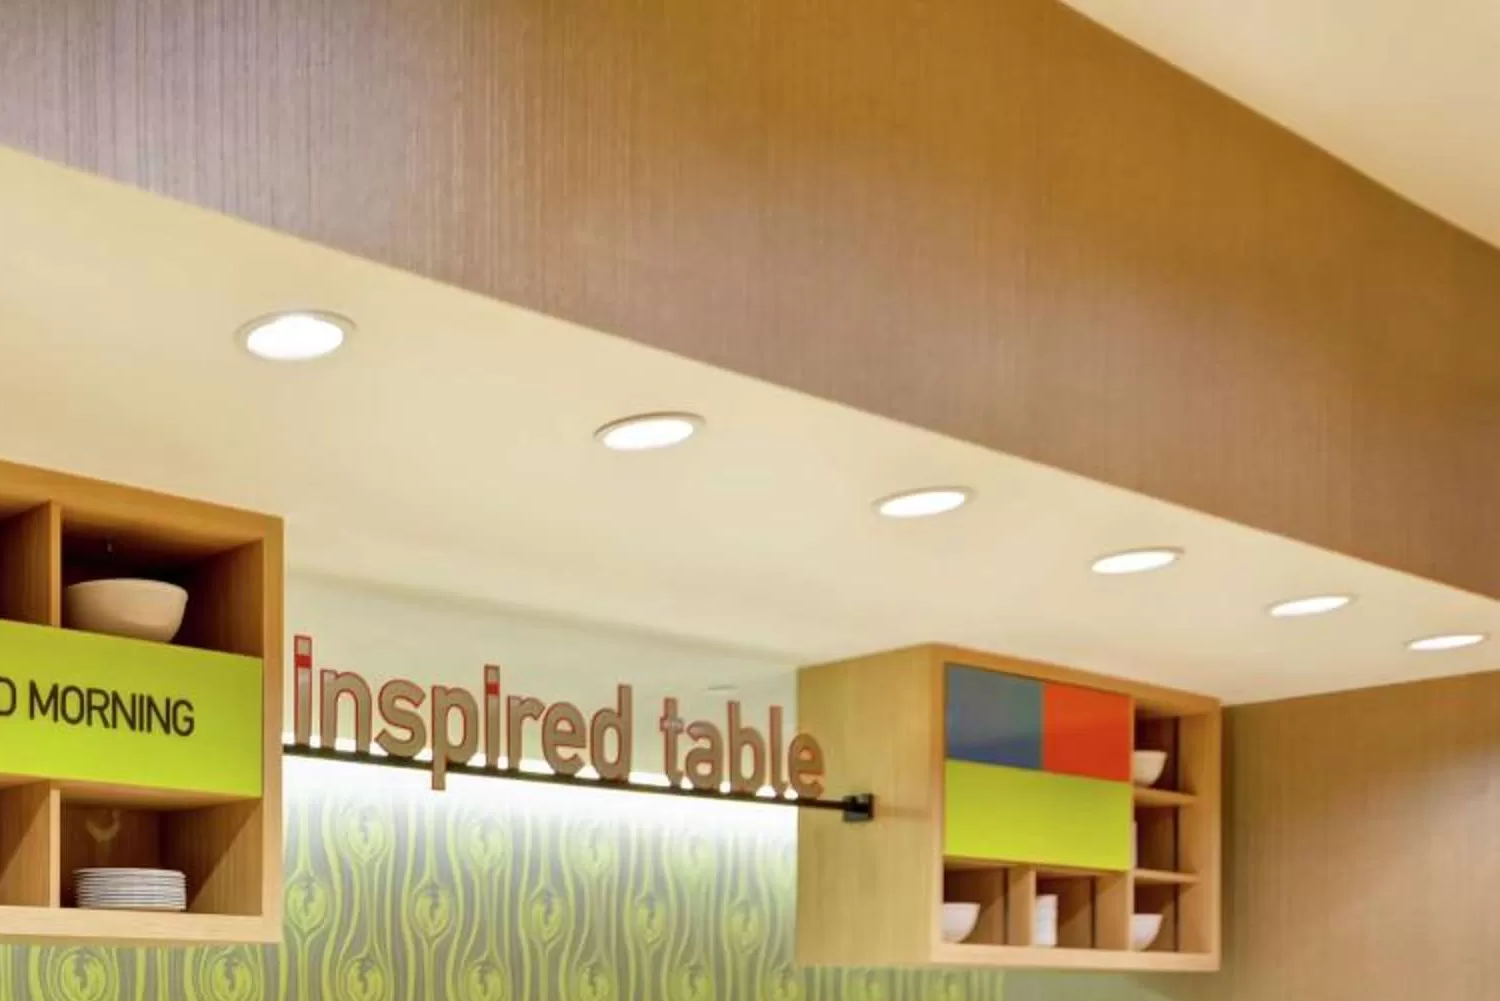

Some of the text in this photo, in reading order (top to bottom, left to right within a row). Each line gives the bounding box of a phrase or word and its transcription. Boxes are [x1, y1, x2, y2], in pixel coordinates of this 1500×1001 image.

[28, 679, 195, 737] MORNING
[294, 634, 825, 799] inspired table
